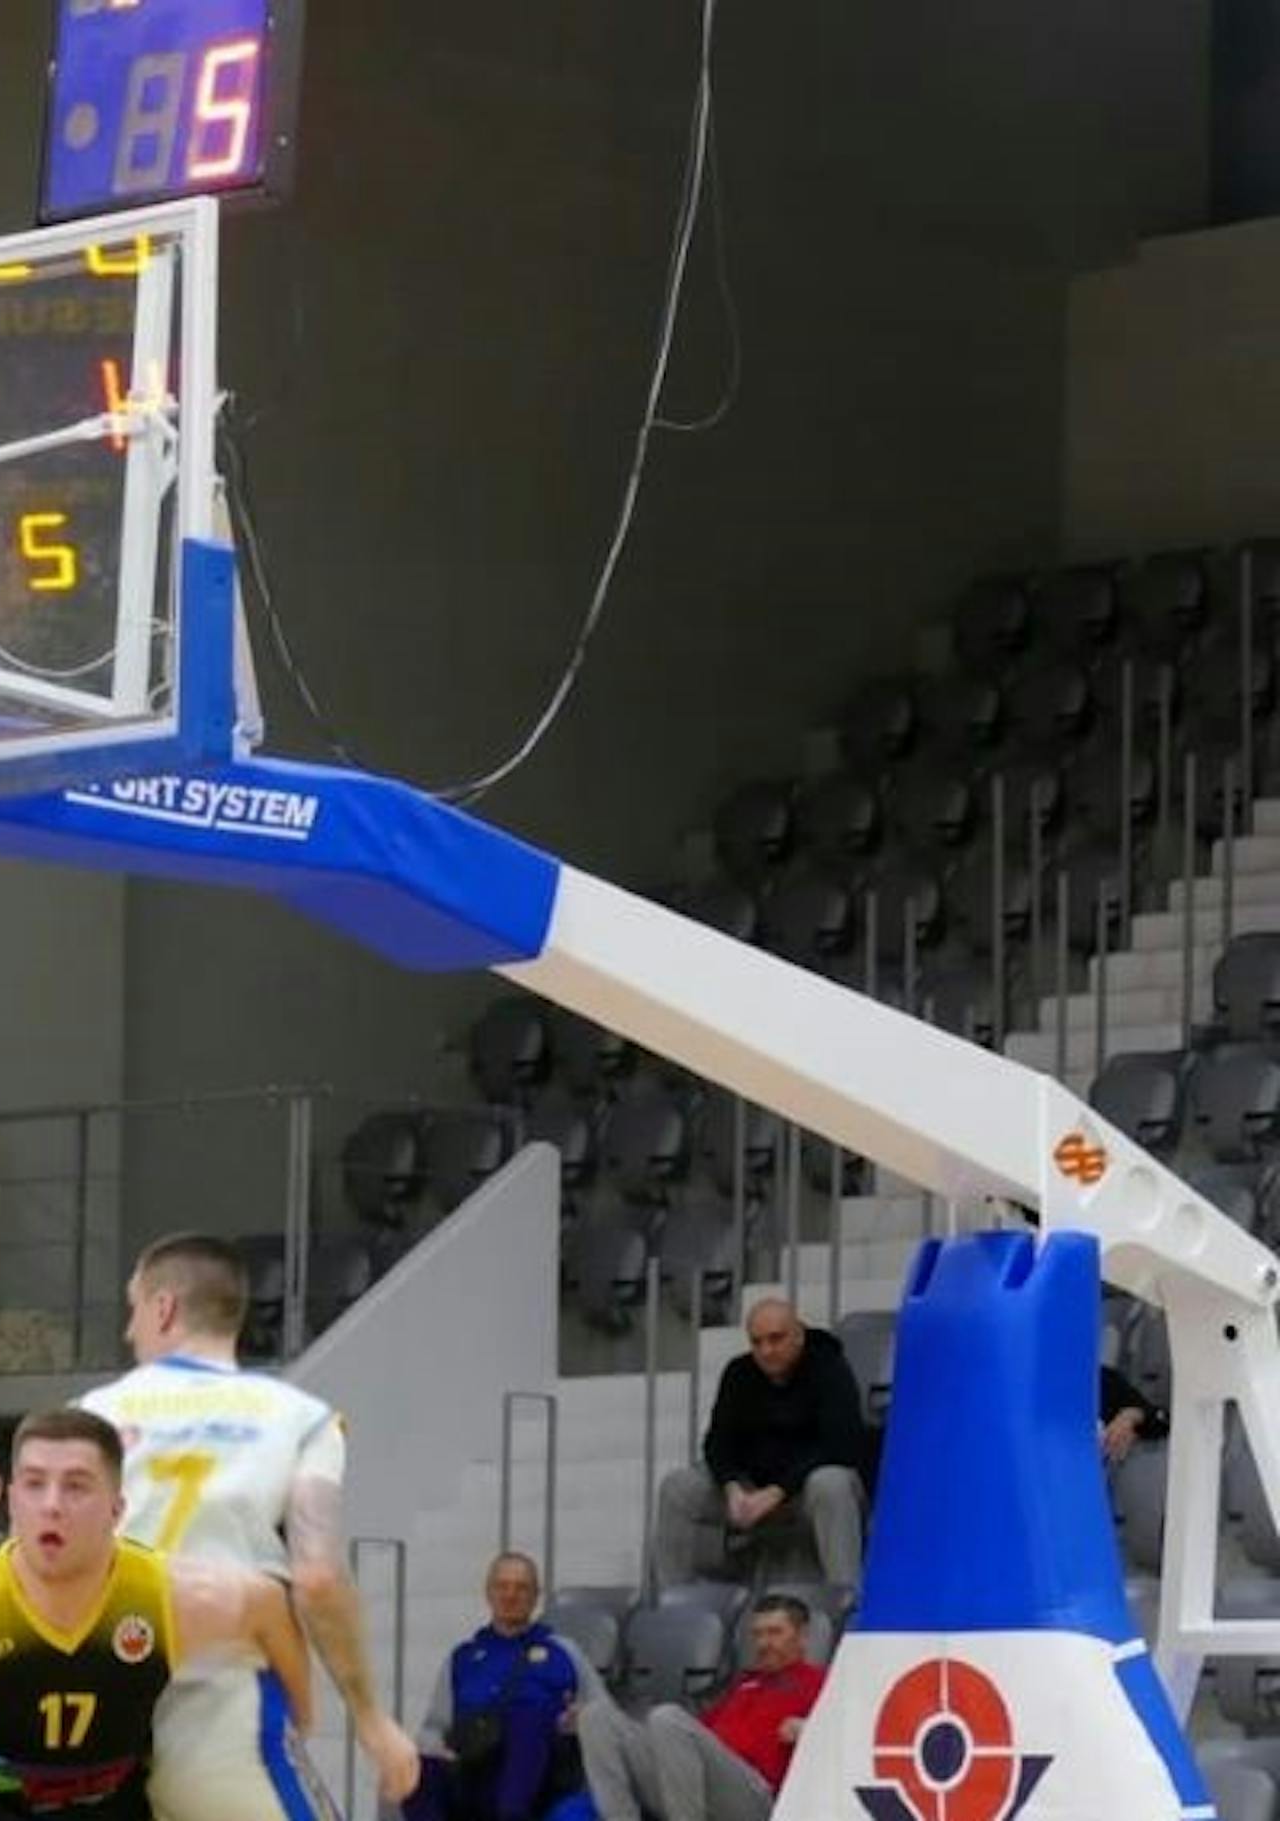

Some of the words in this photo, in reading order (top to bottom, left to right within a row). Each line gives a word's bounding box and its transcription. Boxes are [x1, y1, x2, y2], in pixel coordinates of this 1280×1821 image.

[188, 40, 259, 179] 5
[181, 778, 318, 828] SYSTEM
[147, 1450, 216, 1552] 7
[38, 1692, 97, 1749] 17
